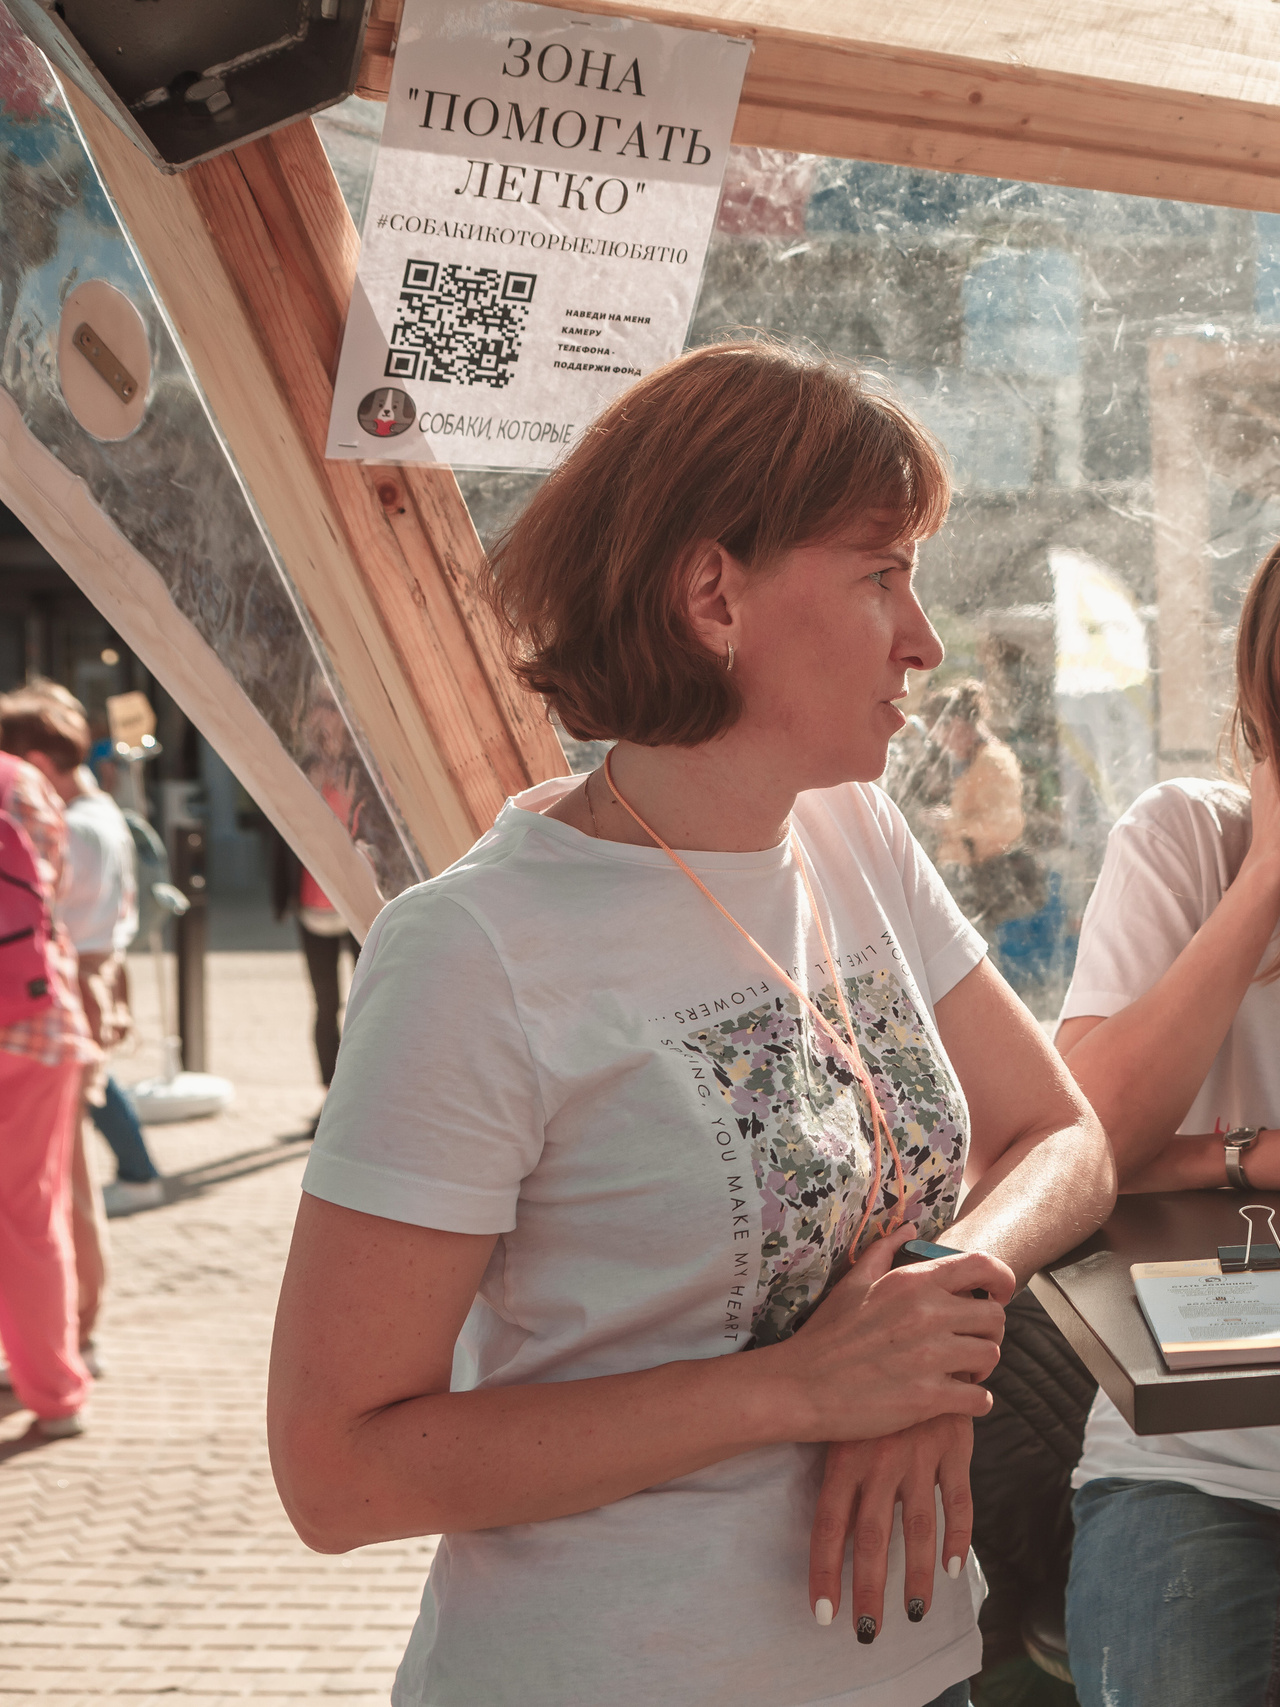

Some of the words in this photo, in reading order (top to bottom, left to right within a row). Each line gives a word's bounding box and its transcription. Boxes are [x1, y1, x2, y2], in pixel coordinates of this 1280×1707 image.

[501, 36, 647, 97] ЗОНА
[407, 87, 712, 166] "ПОМОГАТЬ
[453, 159, 647, 215] ЛЕГКО"
[561, 325, 602, 337] КАМЕРУ
[565, 308, 607, 321] НАВЕДИ
[608, 313, 622, 322] НА
[623, 314, 651, 325] МЕНЯ
[553, 360, 611, 373] ПОДДЕРЖИ
[612, 366, 642, 377] ФОНД
[557, 343, 610, 356] ТЕЛЕФОНА
[418, 411, 493, 441] СОБАКИ,
[496, 418, 575, 445] КОТОРЫЕ
[846, 944, 877, 967] LIKE
[675, 981, 770, 1024] FLOWERS
[711, 1115, 738, 1163] YOU
[726, 1175, 750, 1241] MAKE
[733, 1252, 750, 1281] MY
[723, 1285, 743, 1343] HEART
